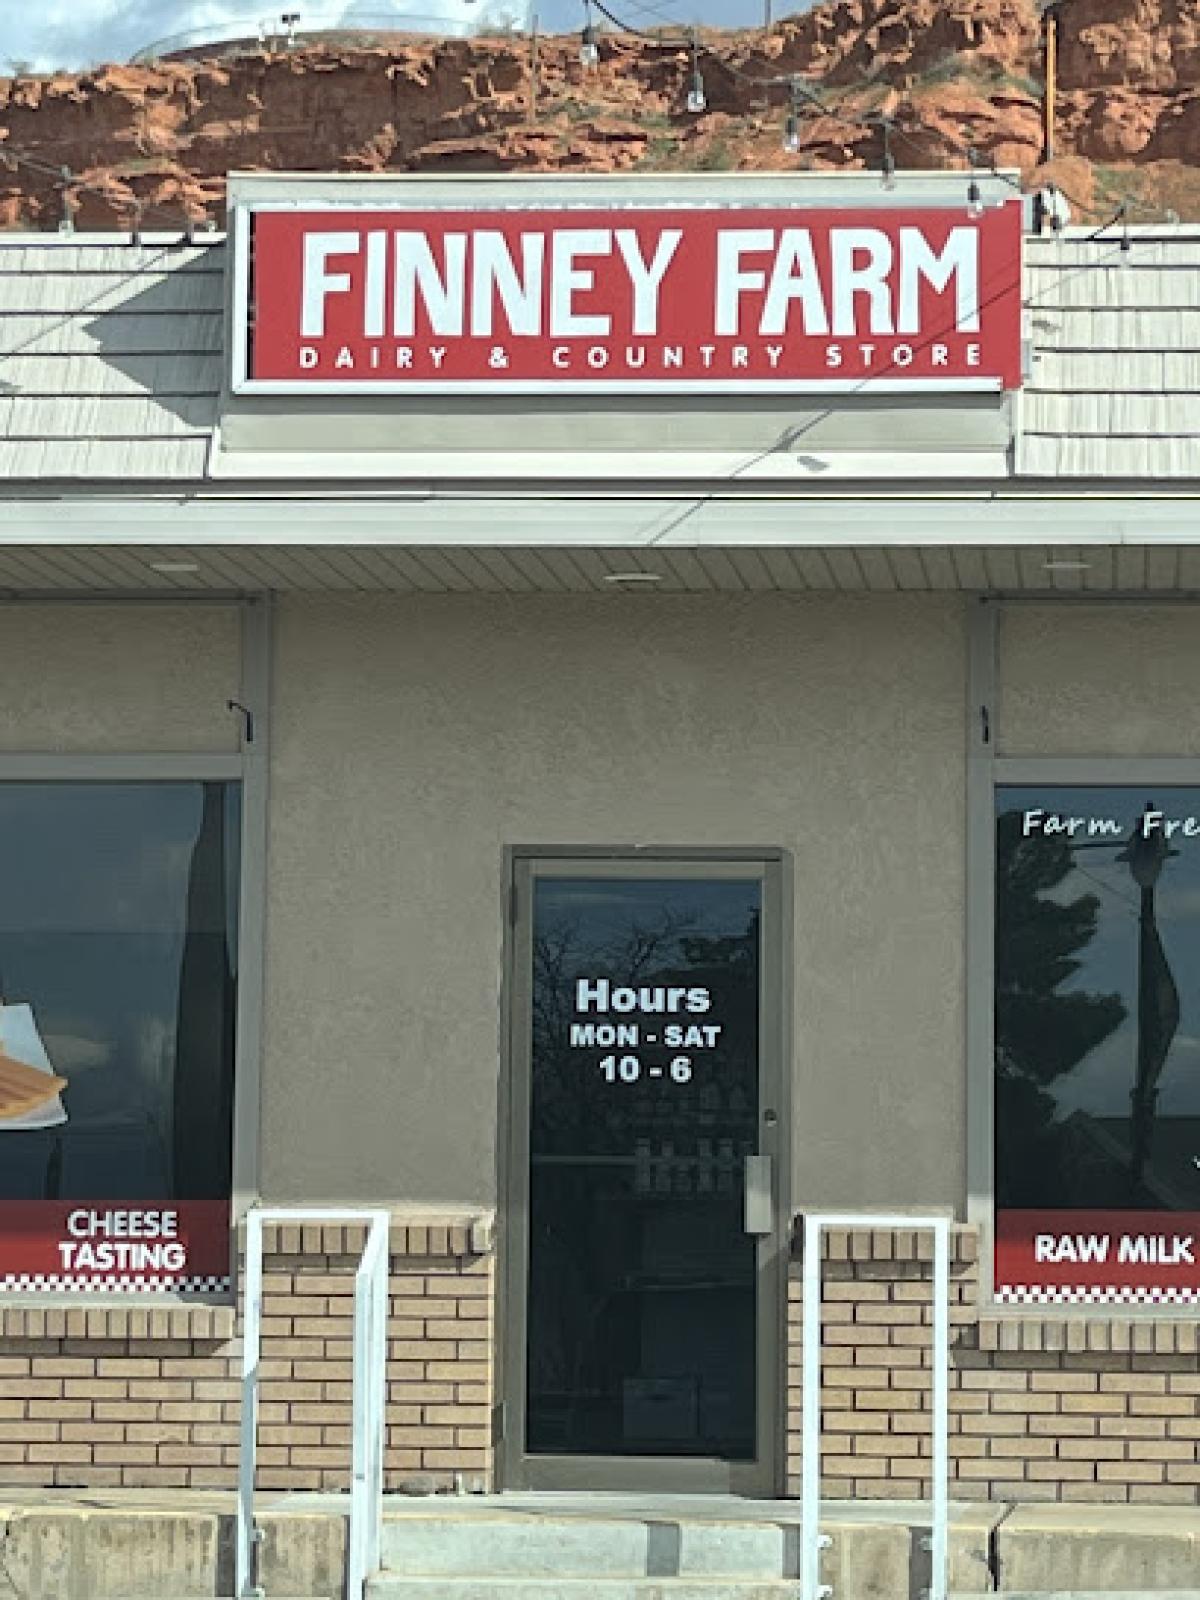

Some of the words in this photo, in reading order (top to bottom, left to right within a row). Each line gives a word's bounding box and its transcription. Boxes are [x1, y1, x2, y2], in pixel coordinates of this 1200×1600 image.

[299, 226, 683, 338] FINNEY
[714, 227, 981, 336] FARM
[299, 347, 446, 369] DAIRY
[487, 346, 509, 369] &
[552, 345, 783, 368] COUNTRY
[825, 343, 981, 367] STORE
[1022, 808, 1124, 837] Farm
[576, 979, 710, 1014] Hours
[570, 1025, 639, 1048] MON
[664, 1025, 722, 1048] SAT
[599, 1056, 640, 1083] 10
[670, 1056, 692, 1083] 6
[66, 1210, 178, 1239] CHEESE
[58, 1241, 187, 1272] TASTING
[1034, 1233, 1110, 1263] RAW
[1117, 1235, 1196, 1265] MILK
